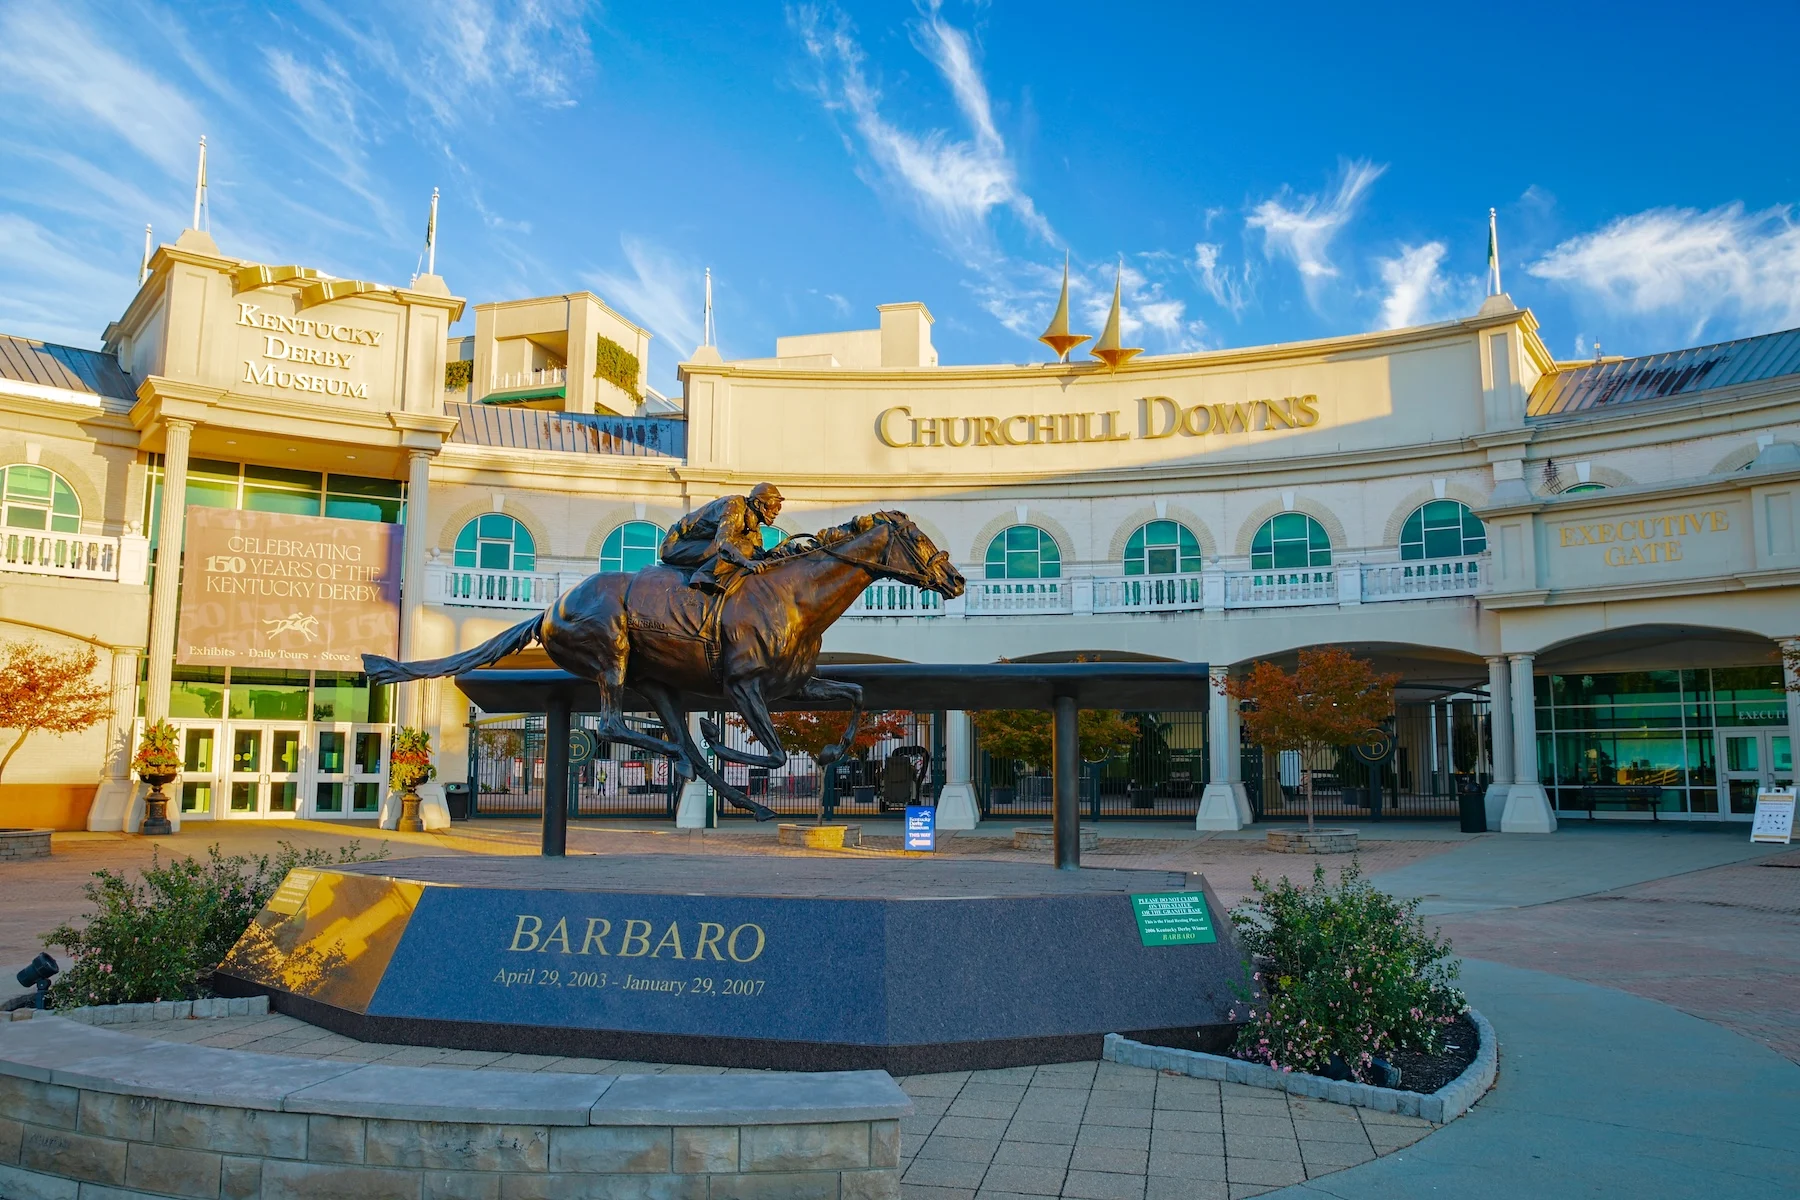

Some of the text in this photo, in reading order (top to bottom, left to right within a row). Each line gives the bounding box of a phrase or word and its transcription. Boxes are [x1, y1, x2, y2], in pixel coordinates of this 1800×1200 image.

[236, 302, 384, 347] KENTUCKY
[262, 335, 355, 369] DERBY
[243, 360, 368, 399] MUSEUM
[876, 394, 1320, 449] CHURCHILL DOWNS
[1559, 509, 1729, 547] EXECUTIVE
[228, 536, 361, 562] CELEBRATING
[1604, 540, 1683, 567] GATE
[204, 555, 381, 583] 150 YEARS OF THE
[206, 576, 381, 602] KENTUCKY DERBY
[189, 646, 350, 662] Exhibits Daily Tours Store
[506, 915, 766, 963] BARBARO
[493, 967, 536, 987] April
[539, 969, 562, 988] 29,
[567, 971, 608, 988] 2003
[623, 974, 687, 996] January
[690, 978, 716, 997] 29,
[721, 979, 766, 996] 2007
